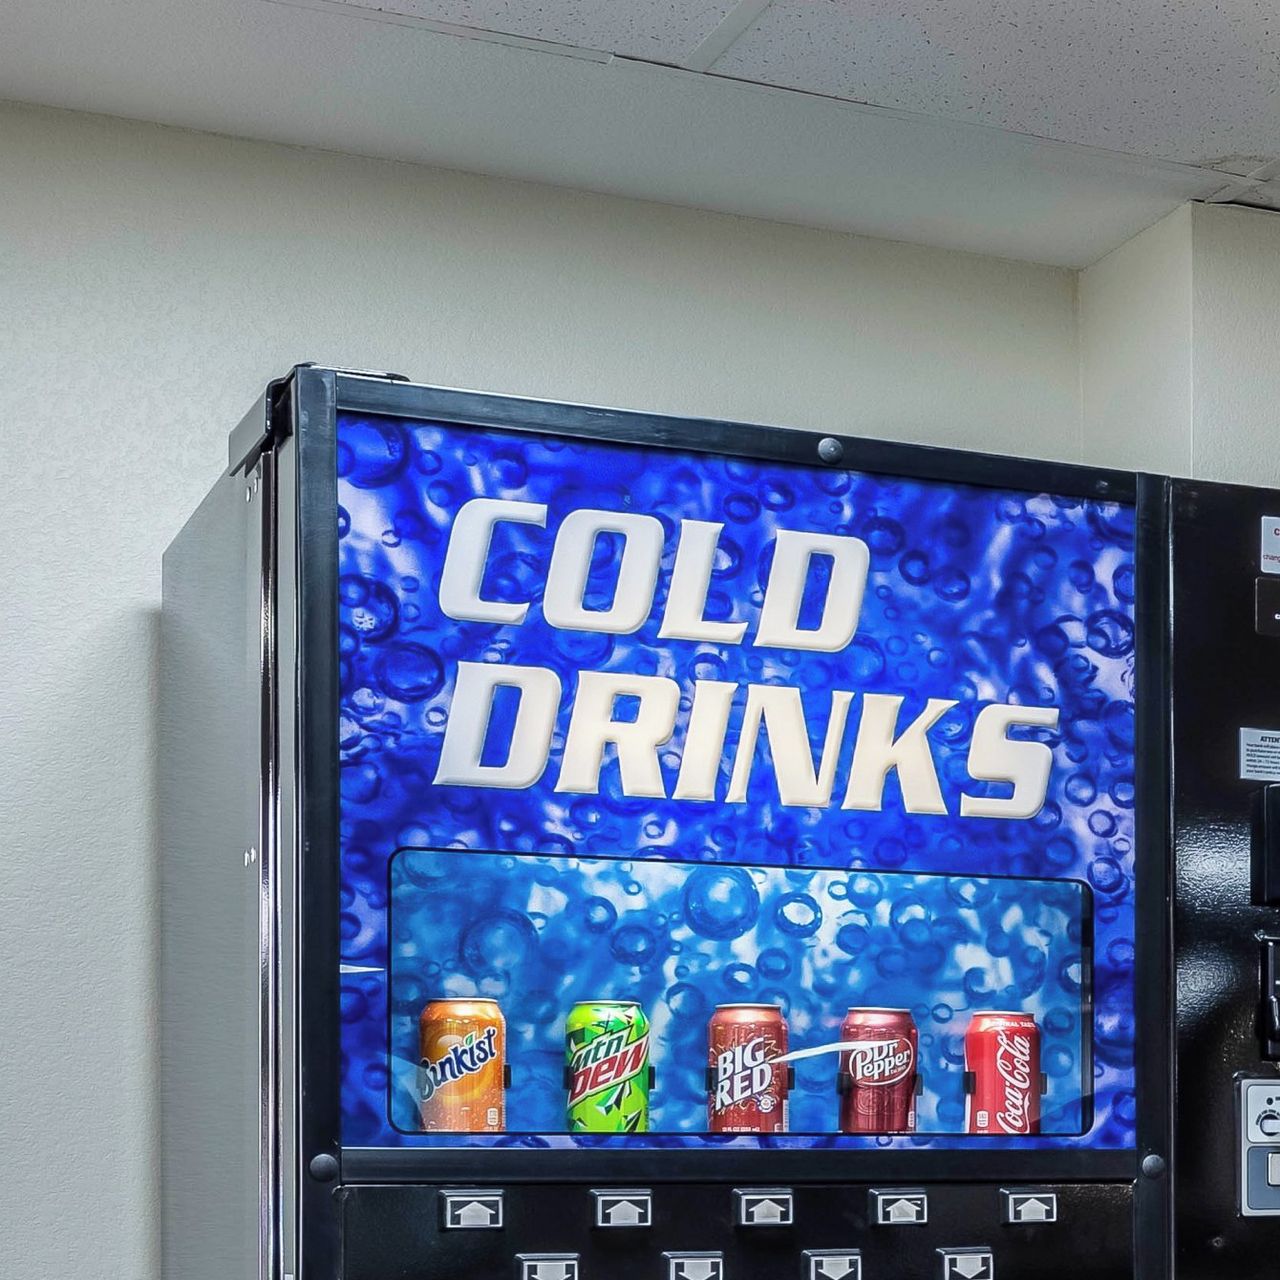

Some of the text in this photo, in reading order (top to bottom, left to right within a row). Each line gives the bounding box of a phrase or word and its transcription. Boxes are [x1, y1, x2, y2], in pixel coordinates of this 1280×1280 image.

[438, 498, 870, 653] COLD
[433, 661, 1060, 820] DRINKS
[420, 1027, 497, 1101] Sunkist
[719, 1038, 766, 1077] BIG
[856, 1048, 911, 1080] Pepper
[873, 1042, 898, 1061] Dr
[716, 1063, 772, 1112] RED
